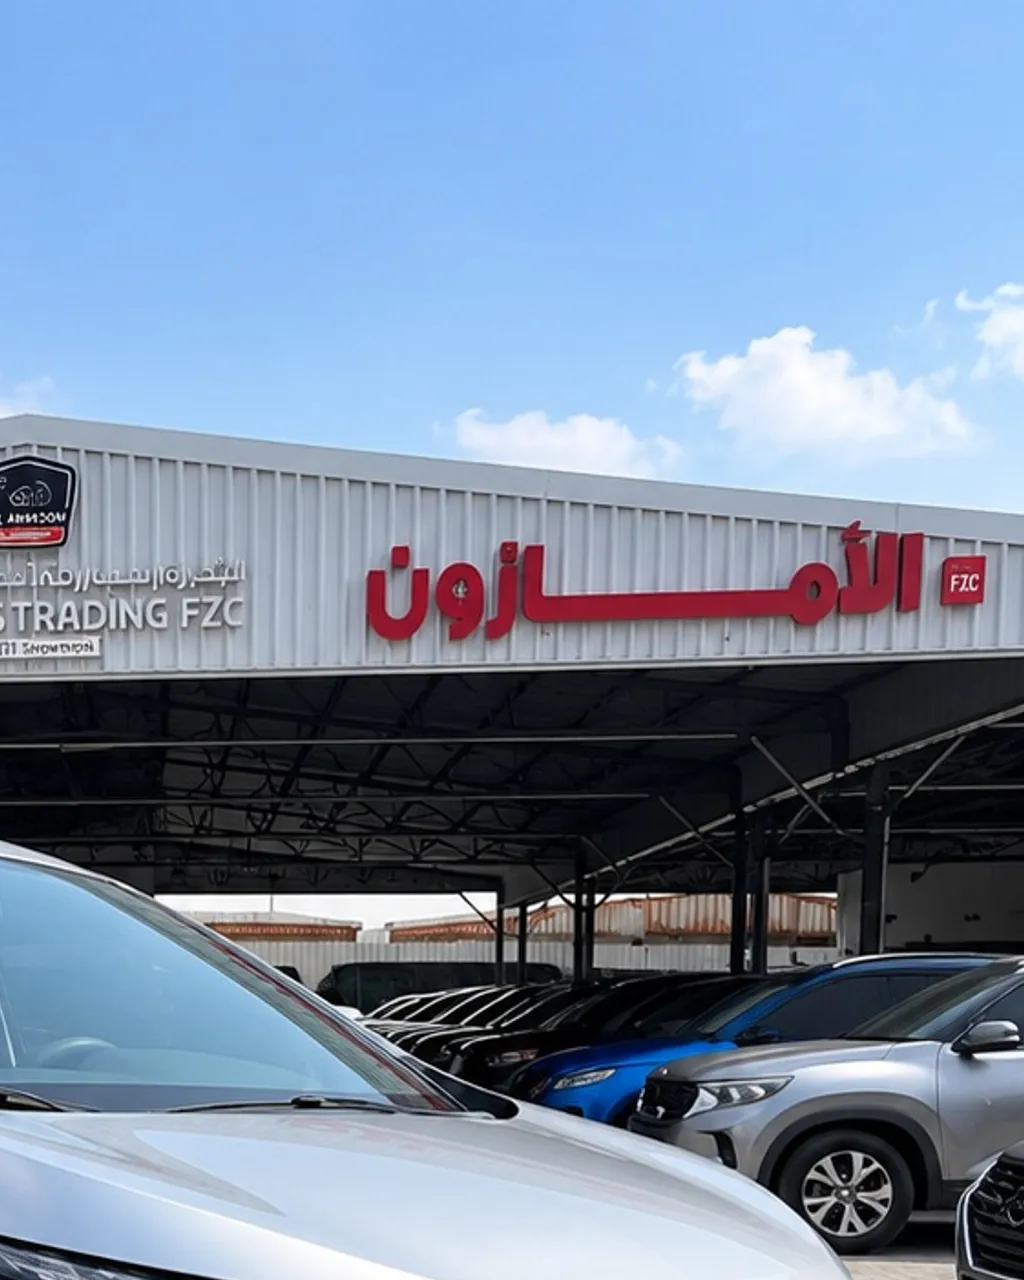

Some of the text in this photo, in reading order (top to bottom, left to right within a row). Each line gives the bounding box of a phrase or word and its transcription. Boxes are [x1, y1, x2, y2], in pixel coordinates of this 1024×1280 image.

[366, 520, 925, 641] الأمازون
[950, 573, 980, 592] FZC
[11, 599, 169, 632] TRADING
[180, 595, 244, 630] FZC
